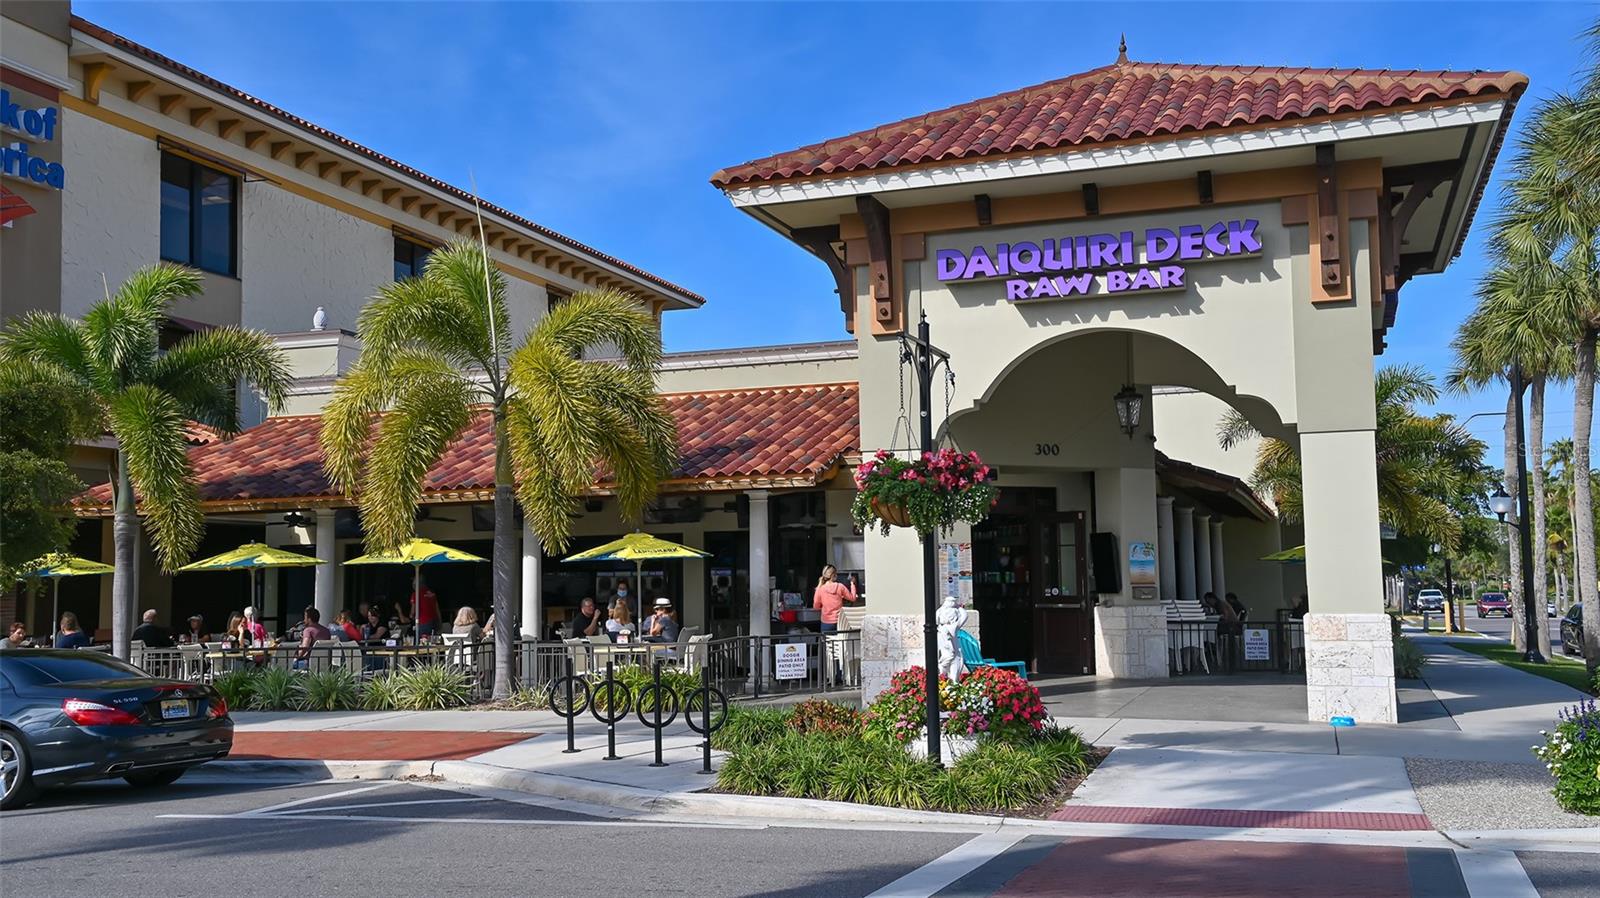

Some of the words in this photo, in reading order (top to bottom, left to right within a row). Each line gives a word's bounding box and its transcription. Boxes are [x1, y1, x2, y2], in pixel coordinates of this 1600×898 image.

[23, 107, 57, 141] of
[0, 143, 65, 190] rica
[936, 231, 1135, 282] DAIQUIRI
[1145, 219, 1263, 263] DECK
[1005, 273, 1094, 301] RAW
[1106, 266, 1186, 293] BAR
[1034, 443, 1060, 456] 300
